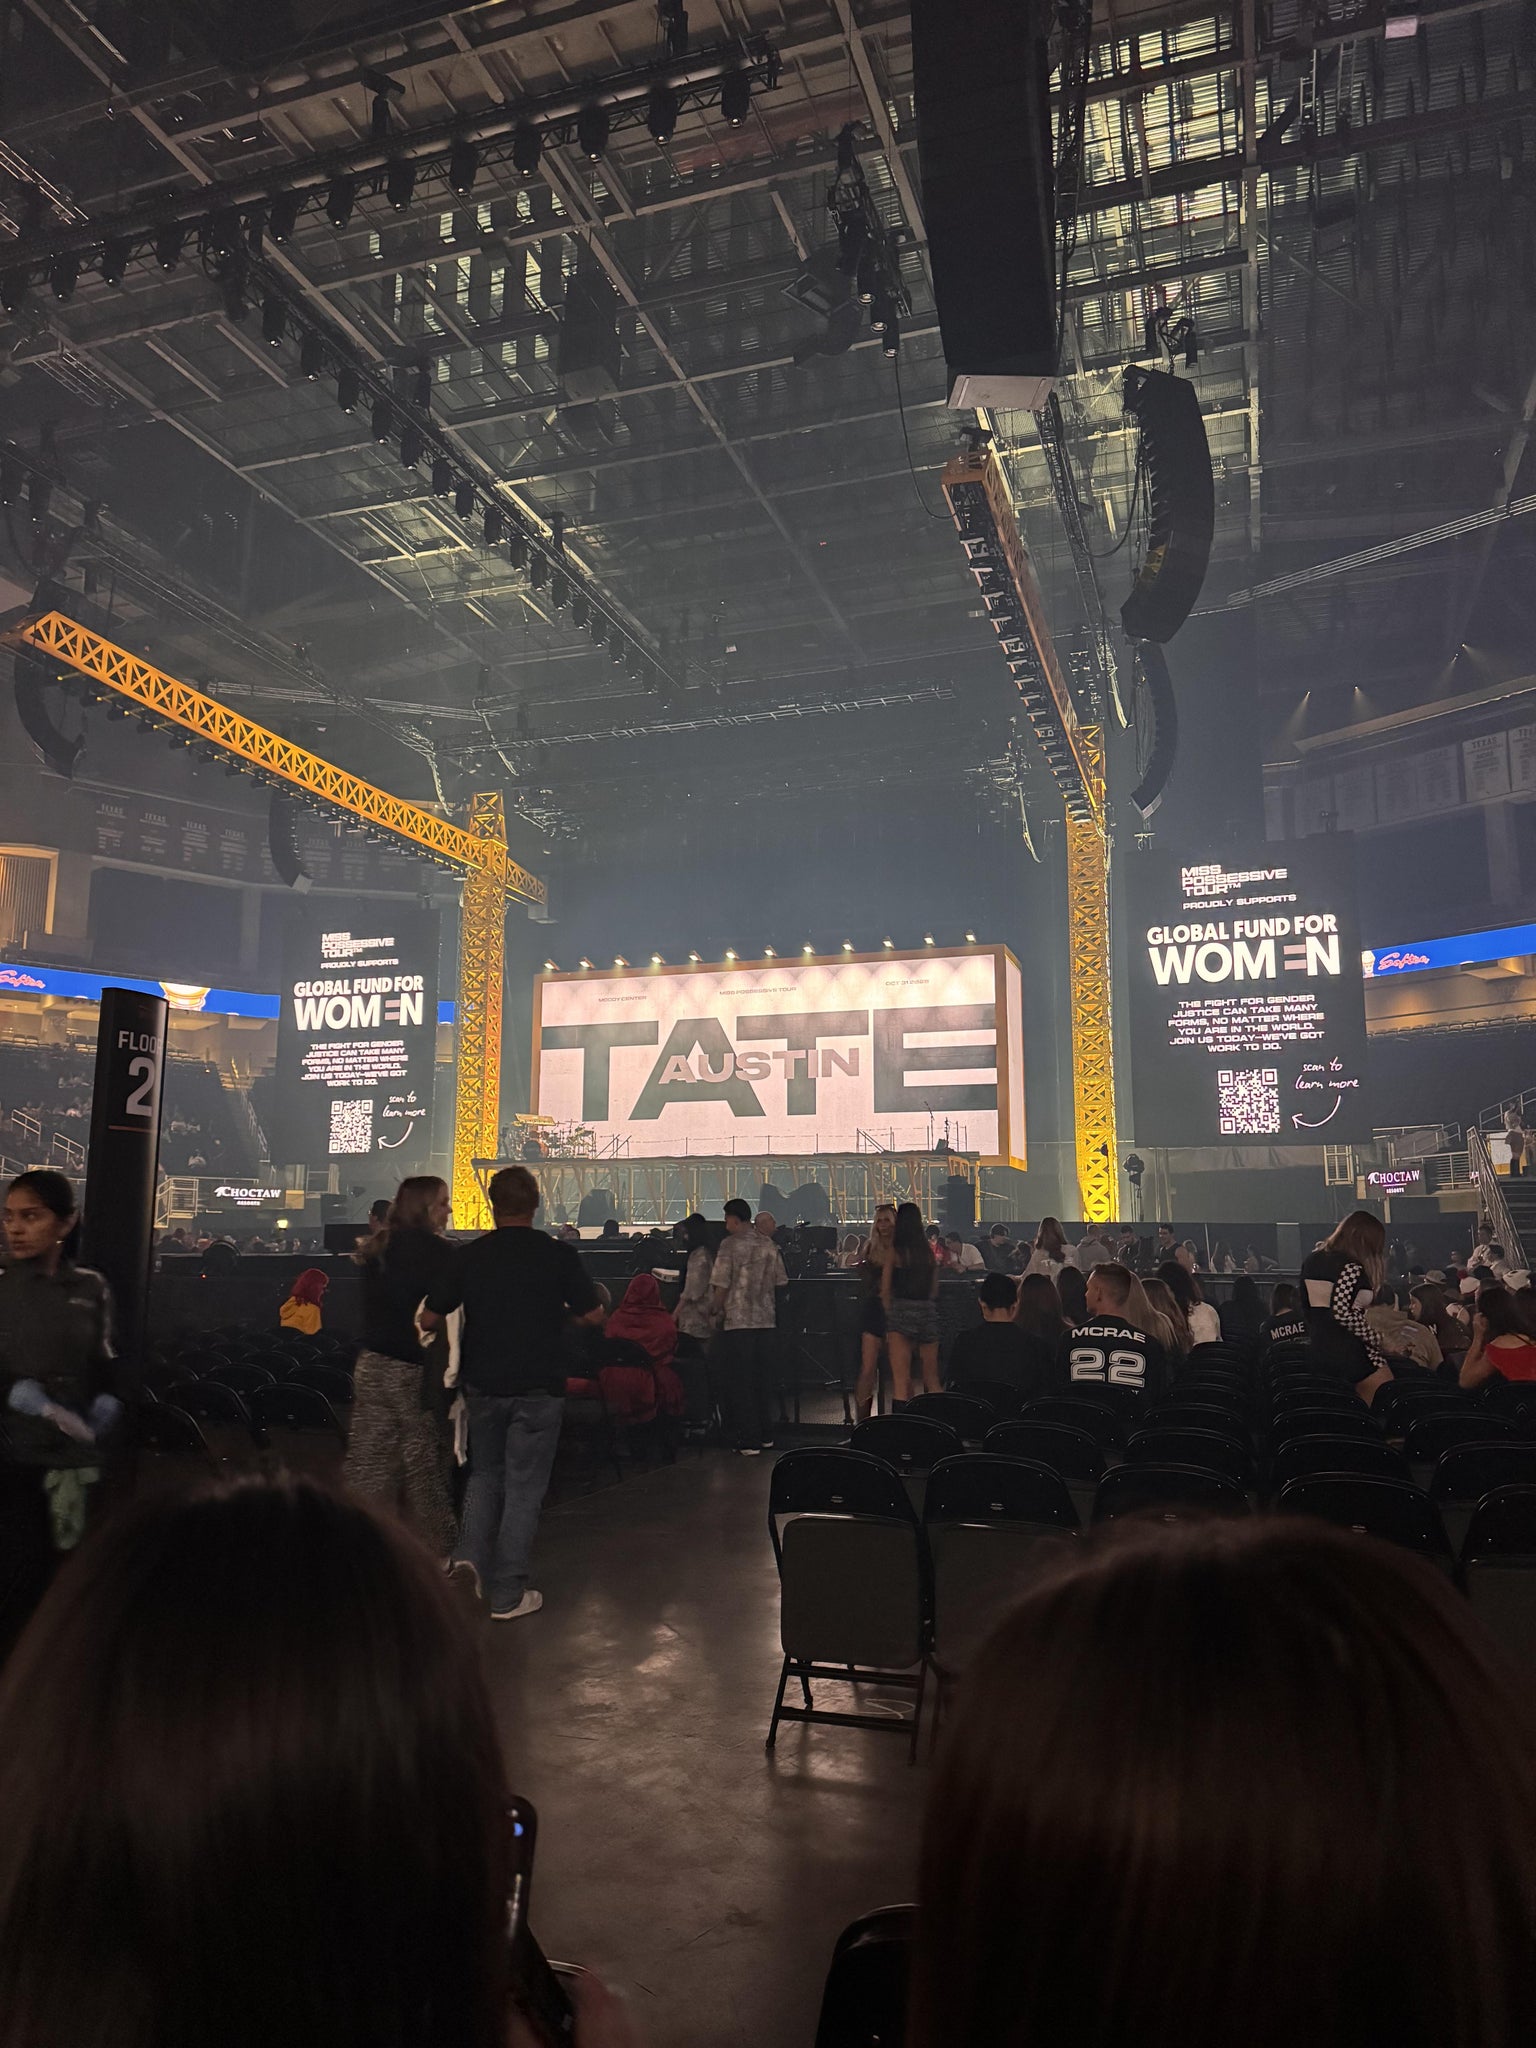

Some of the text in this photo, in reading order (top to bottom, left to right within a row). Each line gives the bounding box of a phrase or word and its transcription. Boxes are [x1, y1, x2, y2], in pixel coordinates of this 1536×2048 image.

[1182, 864, 1222, 878] MISS
[1182, 868, 1288, 887] POSSESSIVE
[1182, 894, 1296, 910] PROUDLY SUPPORTS
[1146, 914, 1338, 945] GLOBAL FUND FOR
[322, 932, 351, 942] MISS
[322, 937, 394, 950] POSSESSIVE
[320, 958, 399, 969] PROUDLY SUPPORTS
[294, 975, 424, 998] GLOBAL FUND FOR
[1178, 1000, 1201, 1008] THE
[1204, 999, 1238, 1007] FIGHT
[1267, 994, 1315, 1004] GENDER
[1172, 1009, 1220, 1018] JUSTICE
[1250, 1006, 1281, 1014] TAKE
[1284, 1004, 1318, 1012] MANY
[1168, 1018, 1210, 1027] FORMS,
[1232, 1015, 1280, 1024] MATTER
[1282, 1012, 1324, 1022] WHERE
[1244, 1024, 1268, 1032] THE
[1272, 1022, 1315, 1031] WORLD.
[1300, 1031, 1324, 1040] GOT
[1208, 1044, 1240, 1052] WORK
[1262, 1042, 1282, 1050] DO.
[541, 1003, 998, 1122] TATE
[658, 1048, 860, 1084] AUSTIN
[1303, 1056, 1343, 1072] scan to
[126, 1056, 155, 1118] 2
[1295, 1074, 1360, 1089] learn more
[406, 1090, 416, 1102] to
[382, 1104, 426, 1117] learn more
[1371, 1170, 1420, 1184] CHOCTAW
[218, 1186, 282, 1198] CHOCTAW
[1072, 1326, 1146, 1344] MCRAE
[1270, 1321, 1305, 1340] MCRAE
[1070, 1348, 1146, 1388] 22
